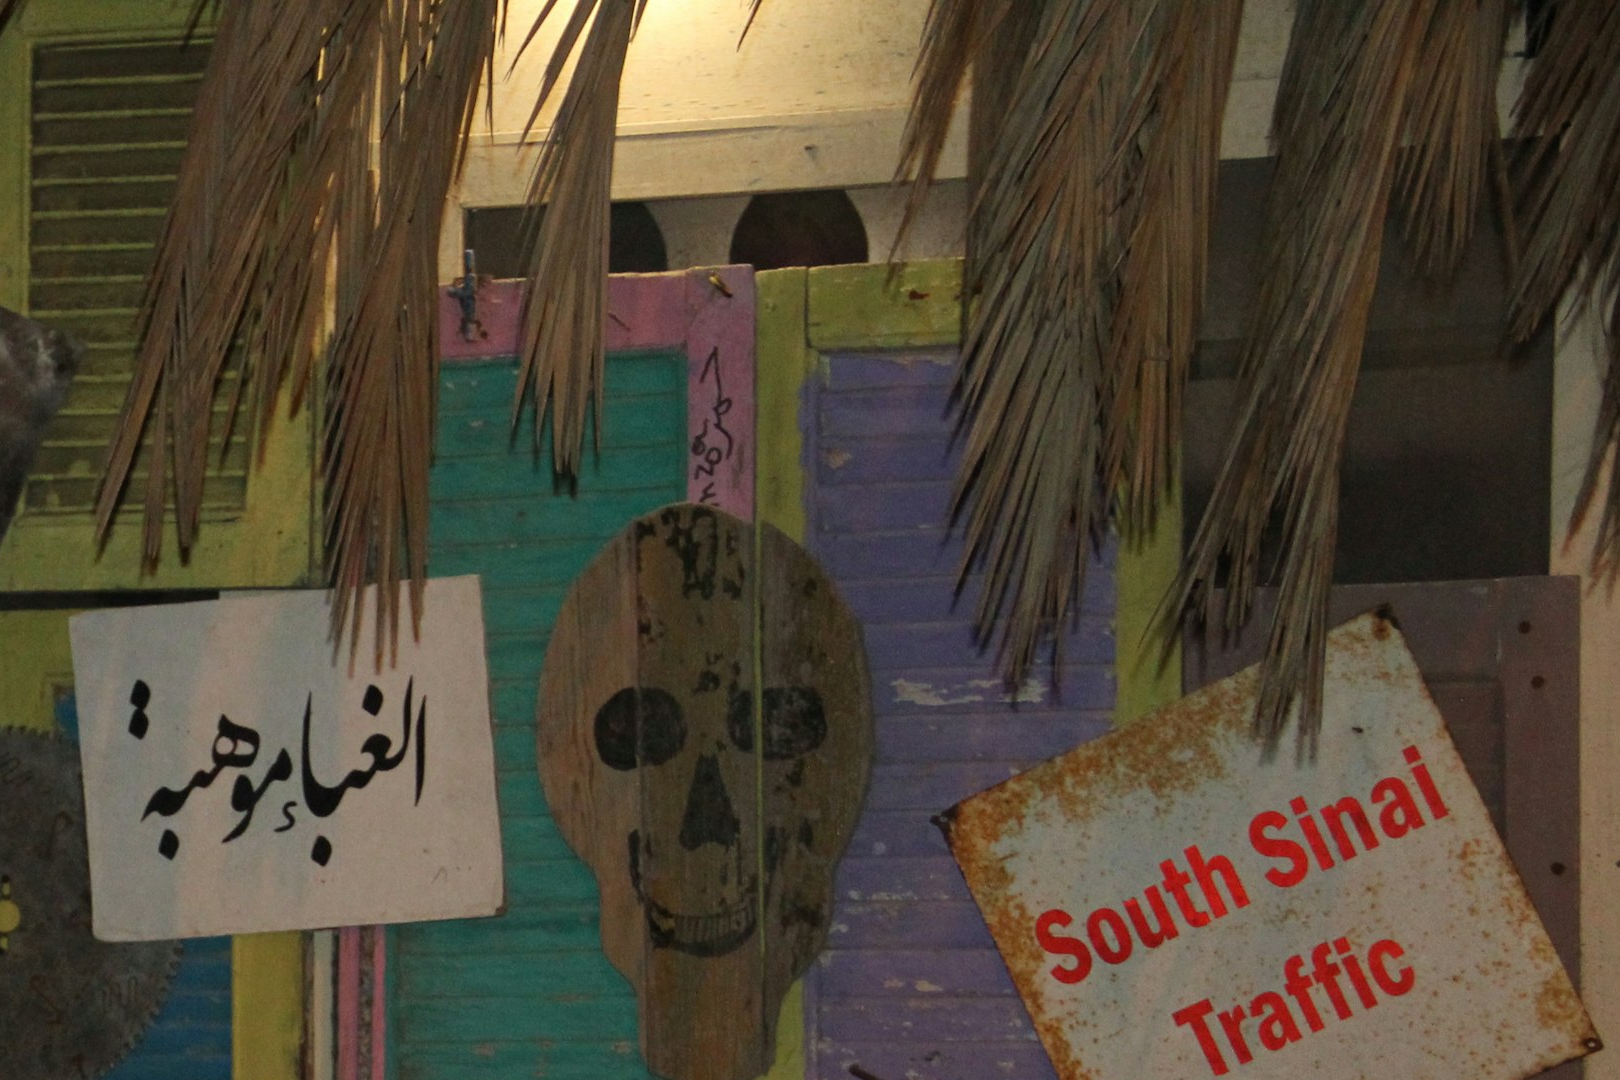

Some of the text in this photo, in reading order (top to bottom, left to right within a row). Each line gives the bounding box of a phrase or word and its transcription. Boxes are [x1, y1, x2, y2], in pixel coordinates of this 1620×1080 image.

[127, 678, 293, 861] موهبة
[1034, 744, 1450, 985] South Sinai
[1172, 936, 1416, 1077] Traffic
